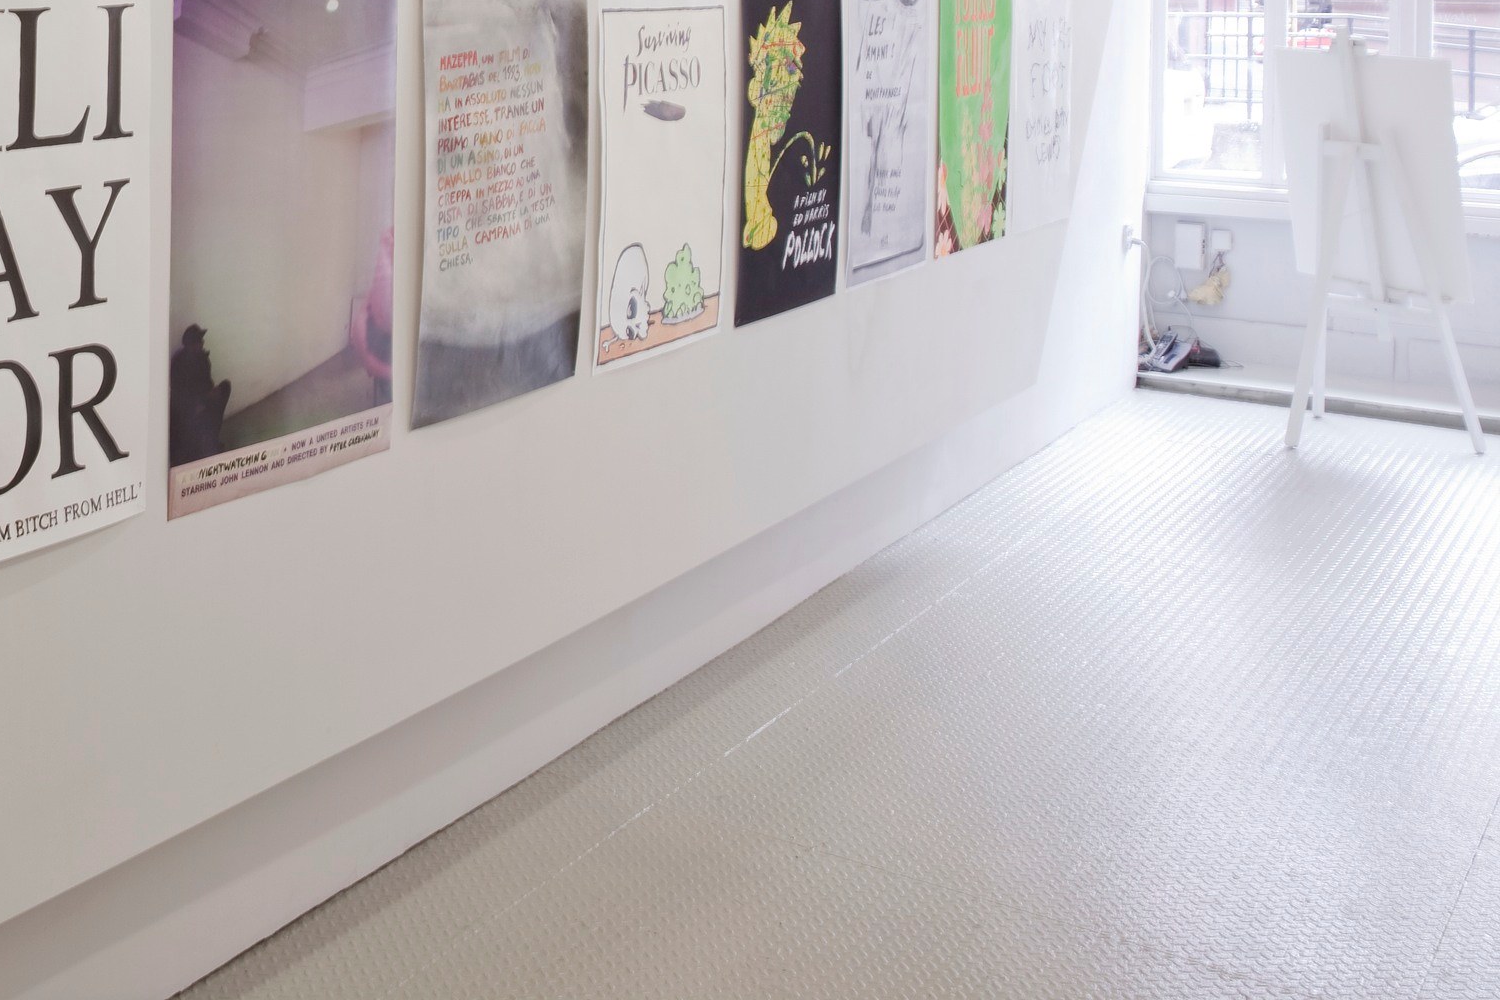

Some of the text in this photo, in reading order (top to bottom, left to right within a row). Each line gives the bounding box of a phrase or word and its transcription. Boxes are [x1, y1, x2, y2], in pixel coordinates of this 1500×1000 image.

[868, 14, 886, 36] LES
[482, 54, 494, 63] UN
[623, 54, 701, 118] PICASSO
[532, 98, 544, 112] UN
[437, 168, 482, 191] CAVALLO
[439, 188, 484, 207] CREPPA IN
[437, 226, 459, 242] TIPO
[475, 222, 521, 244] CAMPANA
[782, 221, 835, 271] POLLOCK
[200, 417, 379, 479] NIGHTWATCHING NOW A UNITED ARTISTS FILM
[181, 480, 217, 497] STARRING
[220, 473, 238, 486] JOHN
[242, 462, 268, 478] LENNON
[271, 459, 284, 470] AND
[288, 449, 317, 464] DIRECTED
[320, 445, 328, 454] BY
[15, 510, 58, 538] BITCH
[64, 495, 102, 523] FROM
